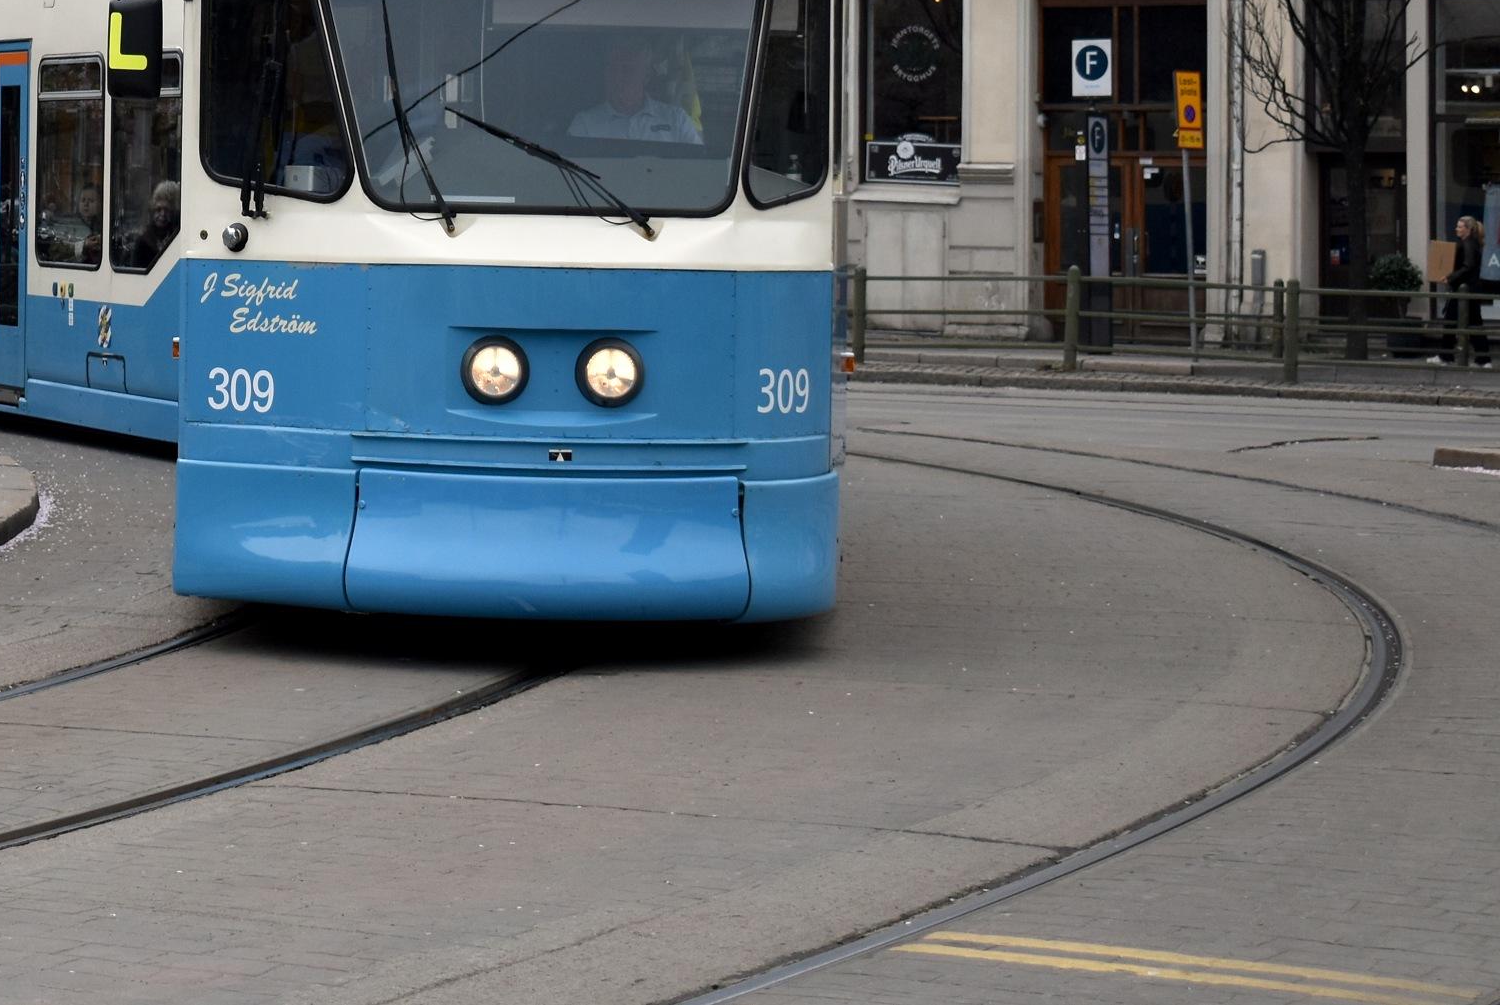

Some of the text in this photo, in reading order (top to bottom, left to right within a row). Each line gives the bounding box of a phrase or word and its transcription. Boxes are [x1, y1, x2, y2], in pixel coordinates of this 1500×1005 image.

[892, 64, 937, 82] BRYGGHUS
[1085, 51, 1098, 75] F
[221, 273, 299, 306] Sigfrid
[229, 307, 318, 334] Edström
[208, 367, 275, 413] 309
[757, 368, 809, 413] 309
